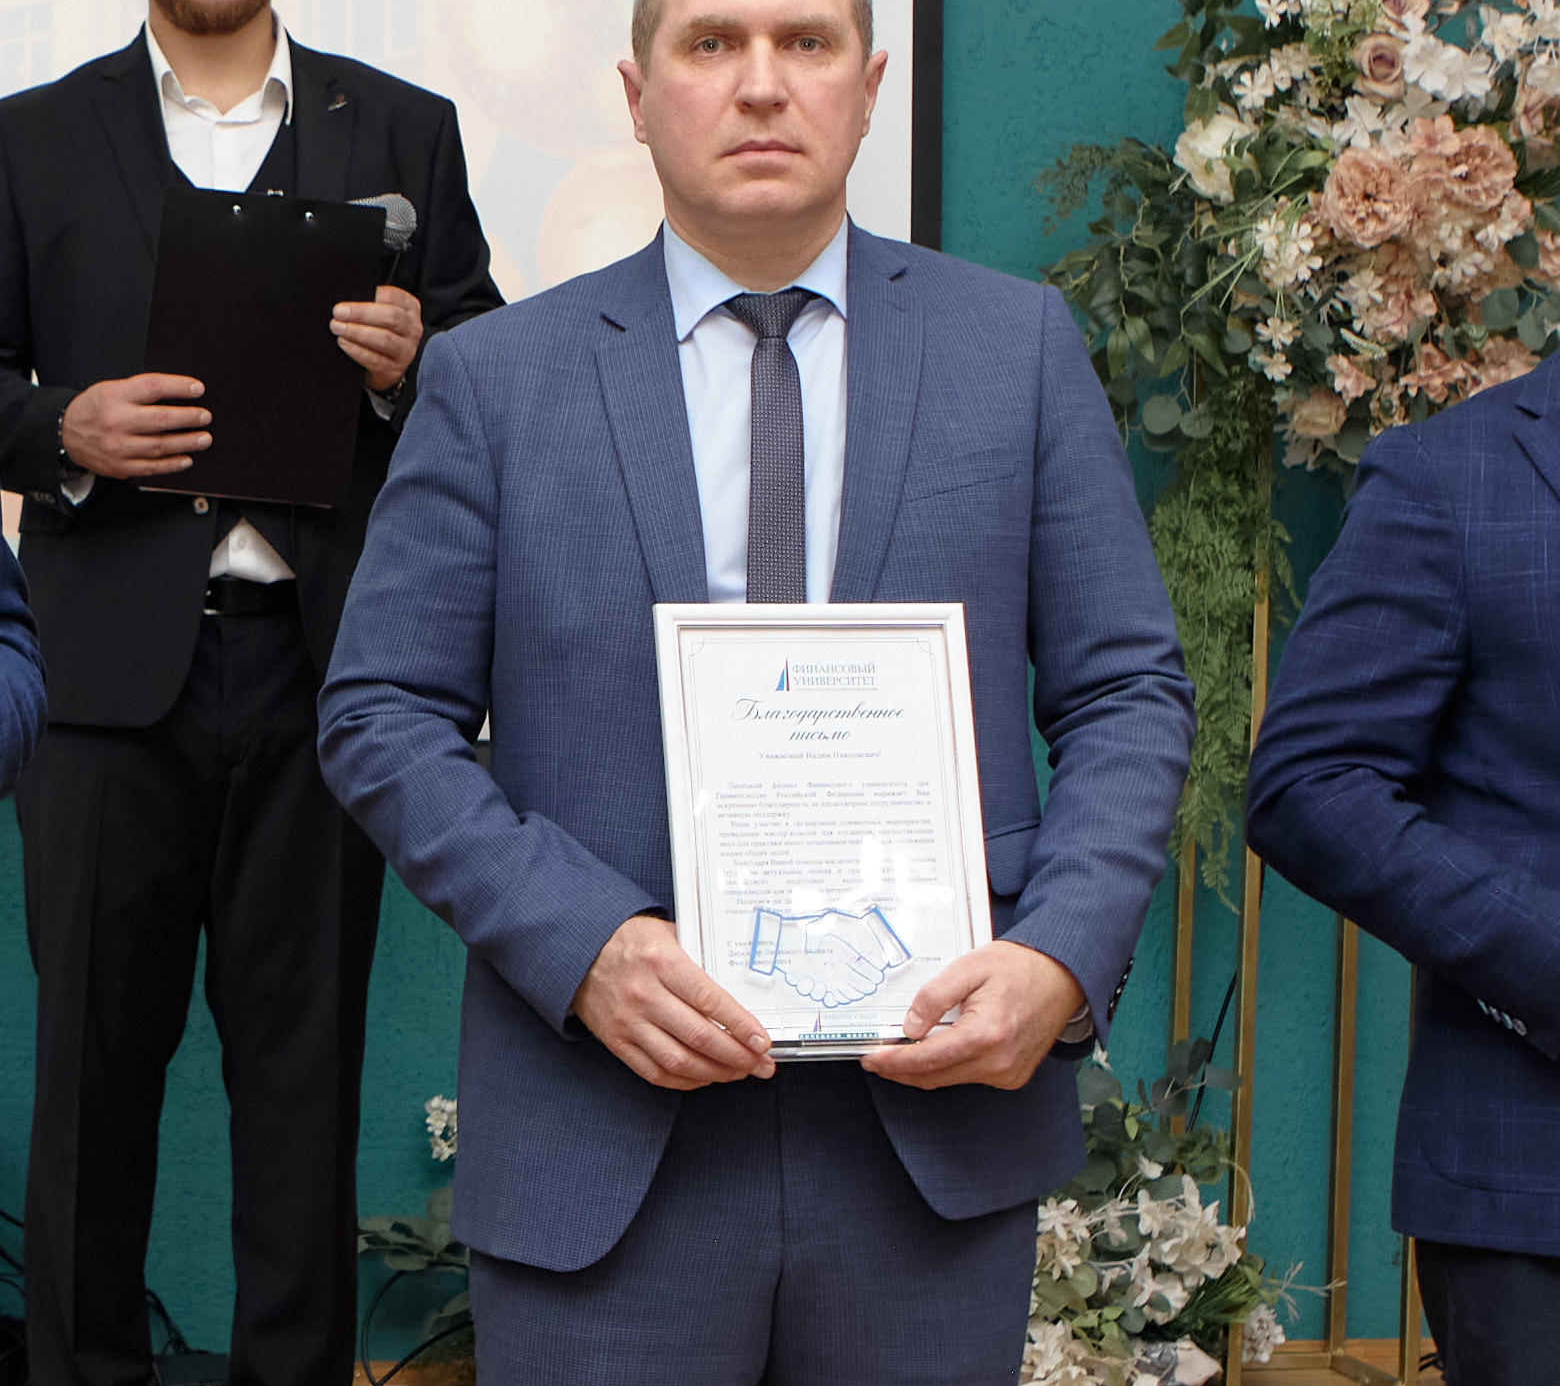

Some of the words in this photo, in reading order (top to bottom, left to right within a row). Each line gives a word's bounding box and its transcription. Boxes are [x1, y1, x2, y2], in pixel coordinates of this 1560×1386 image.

[792, 661, 876, 674] ФИНАНСОВЫЙ
[793, 676, 877, 686] УНИВЕРСИТЕТ
[731, 698, 906, 726] Благодарственное
[788, 730, 851, 741] письмо
